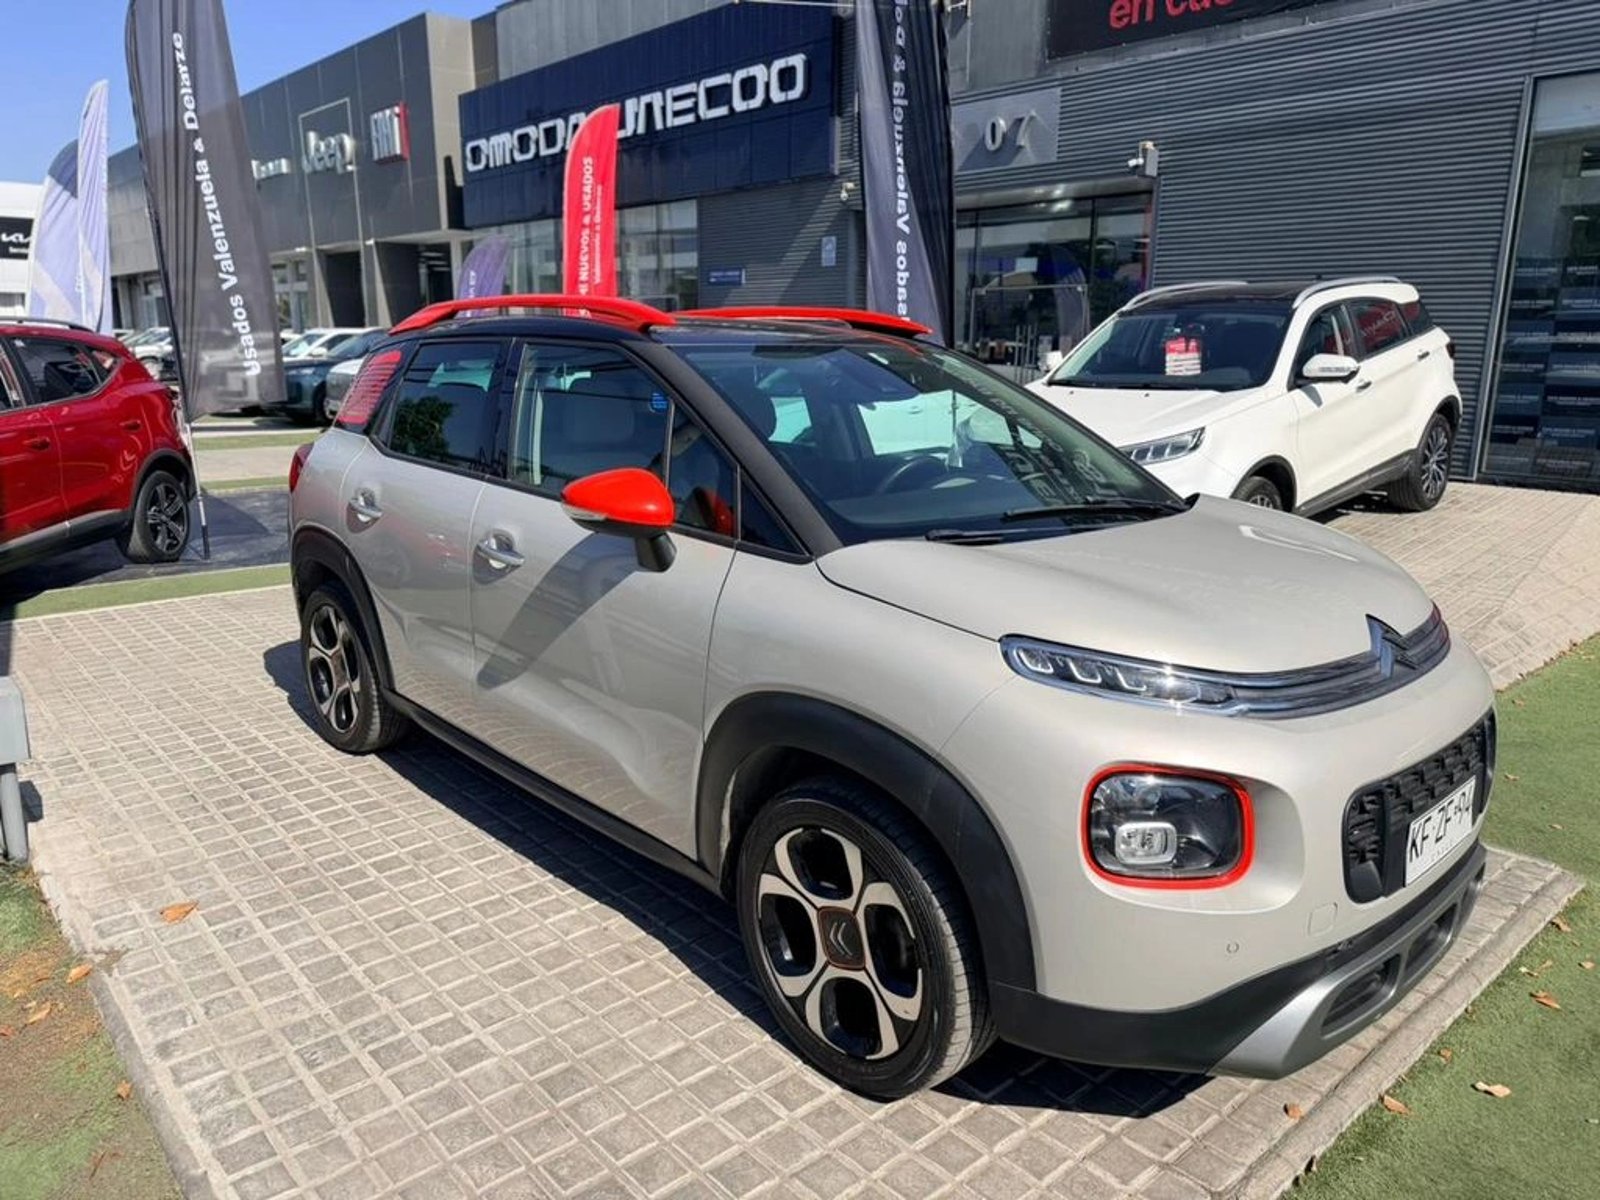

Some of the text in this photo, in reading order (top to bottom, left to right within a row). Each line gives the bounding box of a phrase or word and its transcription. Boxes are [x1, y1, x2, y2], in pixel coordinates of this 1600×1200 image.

[172, 32, 199, 130] Delarze
[302, 130, 357, 175] Jeep
[582, 156, 594, 211] USADOS
[195, 159, 238, 290] Valenzuela
[579, 228, 591, 282] NUEVOS
[229, 294, 261, 377] Usados
